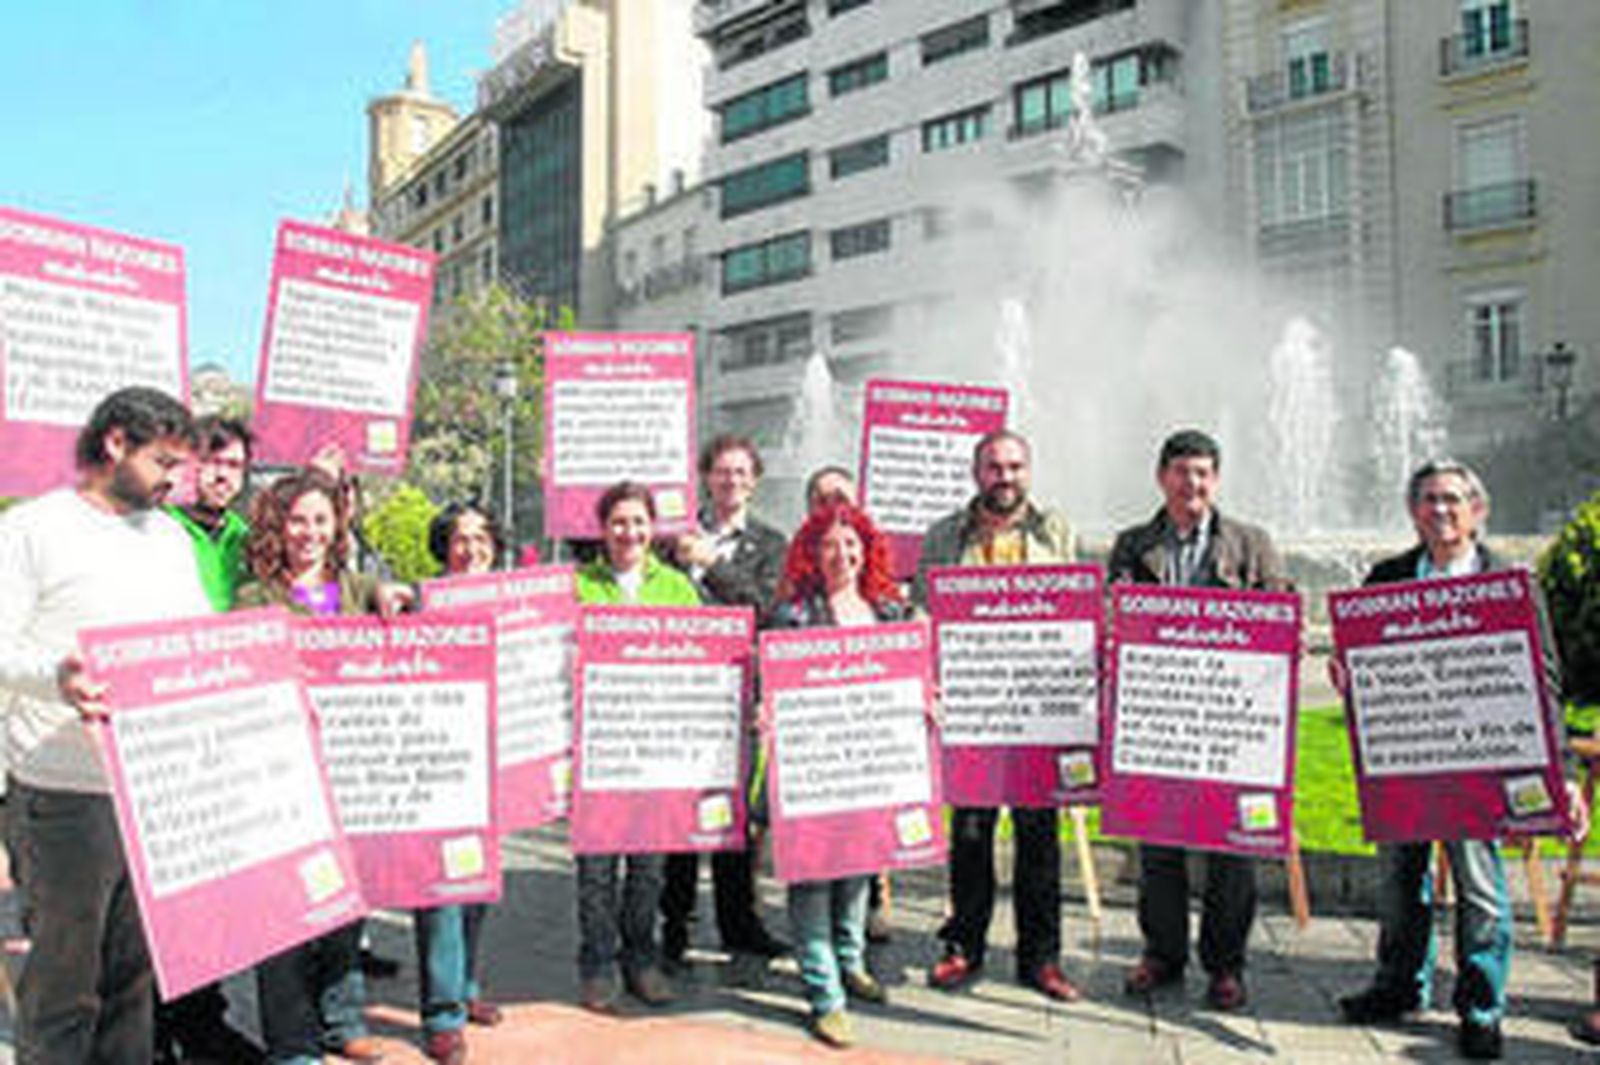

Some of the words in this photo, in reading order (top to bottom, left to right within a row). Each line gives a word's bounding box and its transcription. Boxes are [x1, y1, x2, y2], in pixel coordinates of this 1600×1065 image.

[1119, 595, 1199, 616] SOBRAN
[1204, 600, 1295, 623] RAZONES
[1336, 589, 1419, 619] SOBRAN
[1423, 578, 1524, 608] RAZONES
[391, 623, 489, 646] RAZONES
